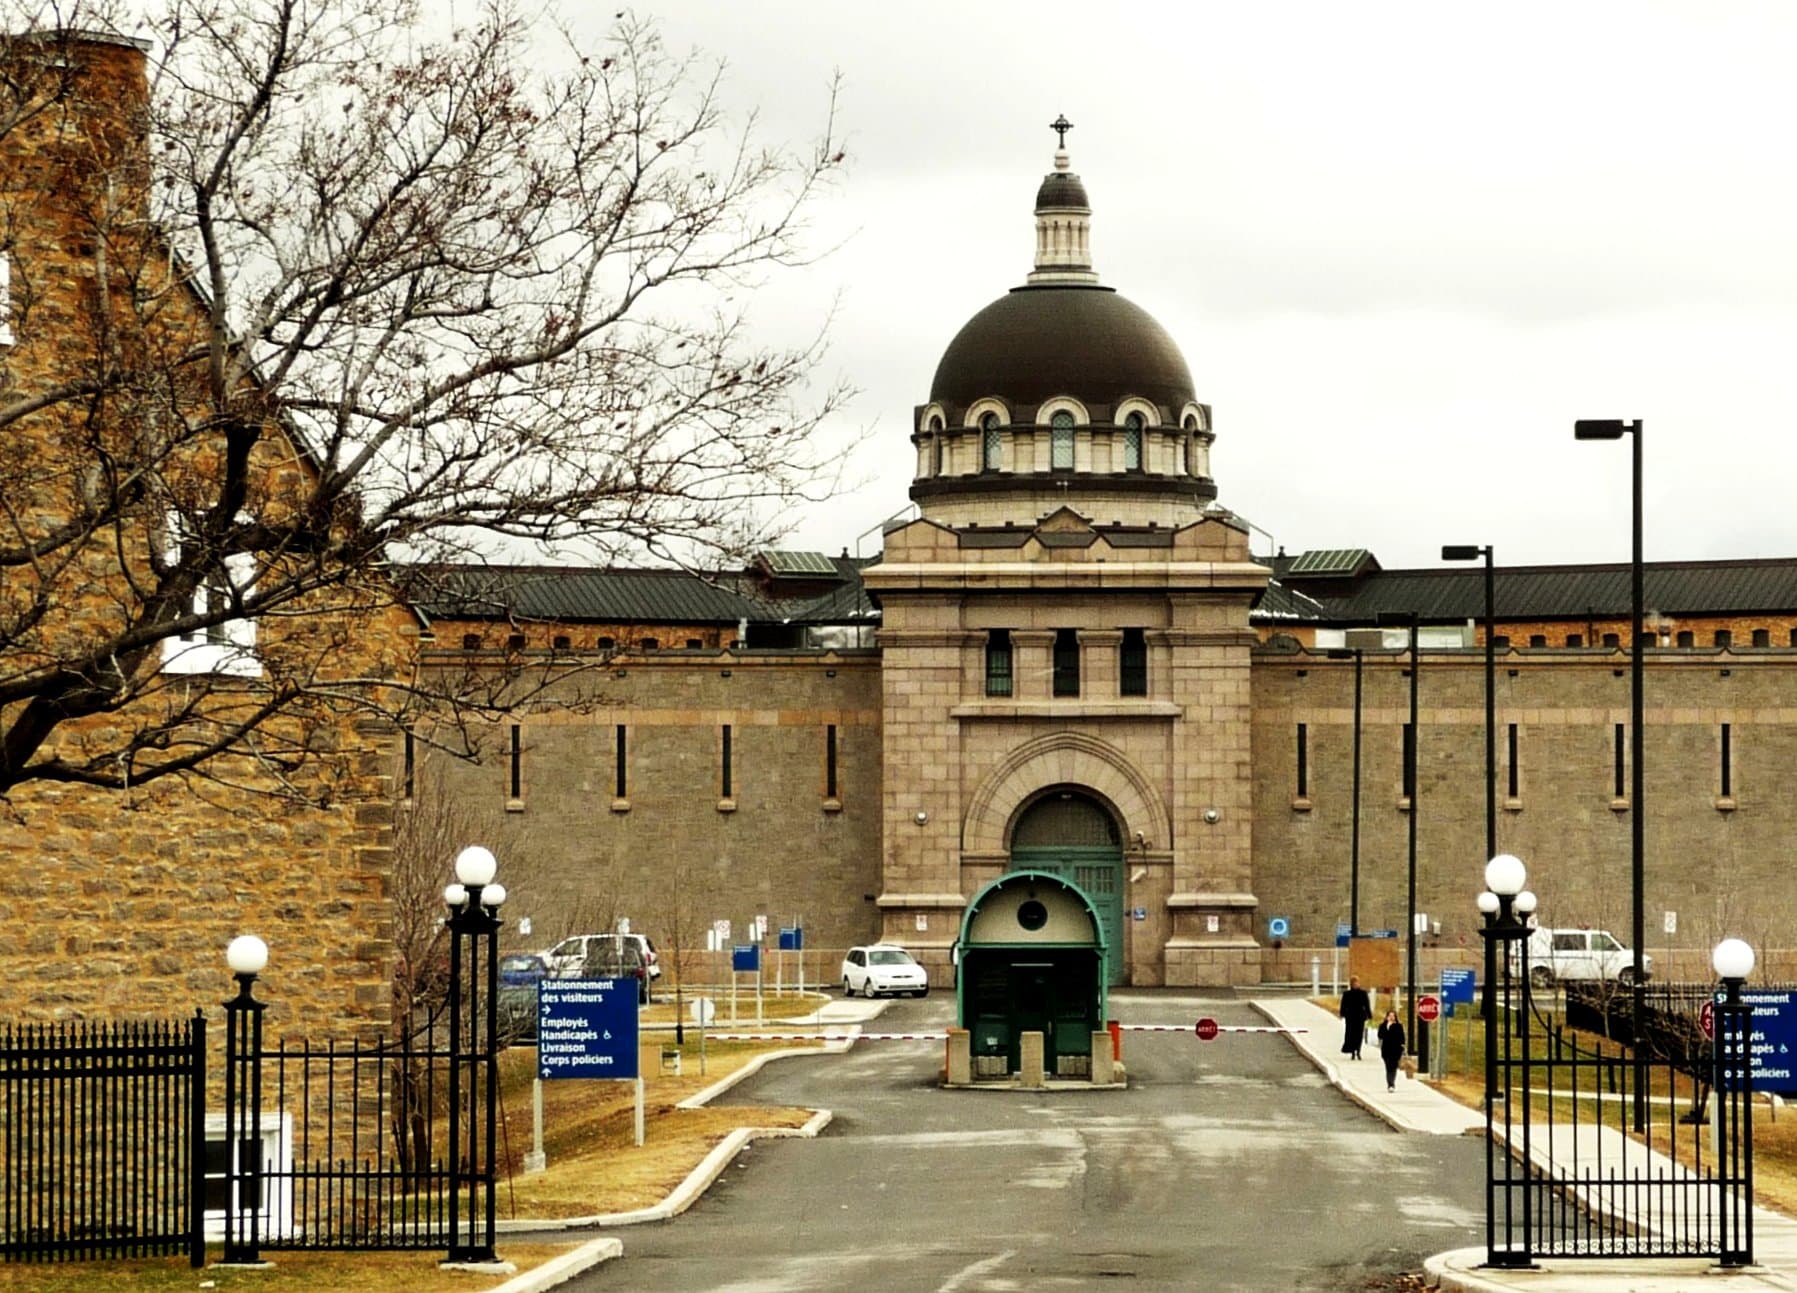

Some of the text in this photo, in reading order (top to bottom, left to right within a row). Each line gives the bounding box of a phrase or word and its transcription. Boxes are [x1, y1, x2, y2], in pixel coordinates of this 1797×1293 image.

[541, 980, 614, 990] Stationnement
[541, 992, 603, 1002] des visiteurs
[541, 1017, 589, 1029] Employés
[541, 1030, 598, 1042] Handicapés
[541, 1042, 586, 1053] Livraison
[541, 1054, 614, 1067] Corps policiers
